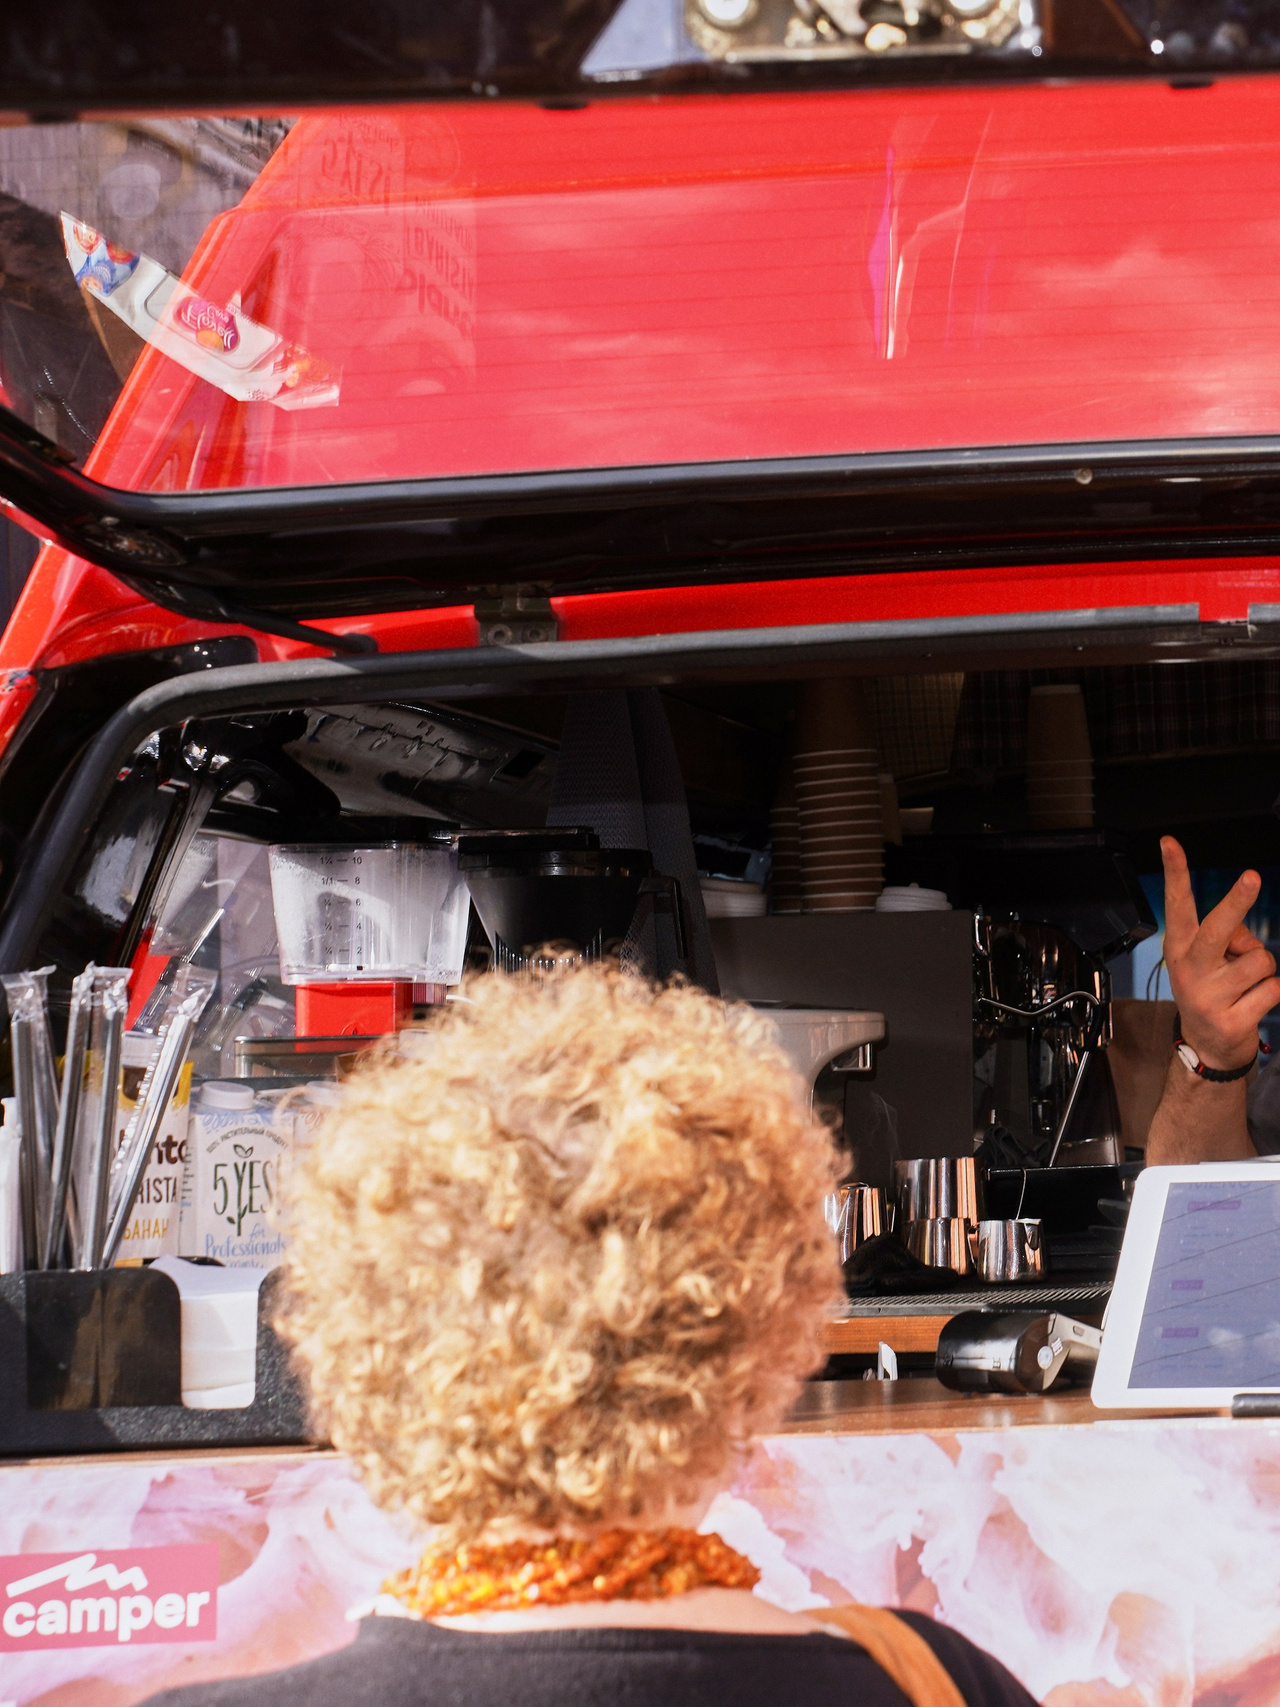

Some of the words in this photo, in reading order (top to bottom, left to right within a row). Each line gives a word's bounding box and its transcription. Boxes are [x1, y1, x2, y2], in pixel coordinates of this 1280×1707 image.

[352, 856, 363, 865] 10
[354, 876, 361, 885] 8
[213, 1163, 229, 1216] 5
[2, 1591, 210, 1642] camper
